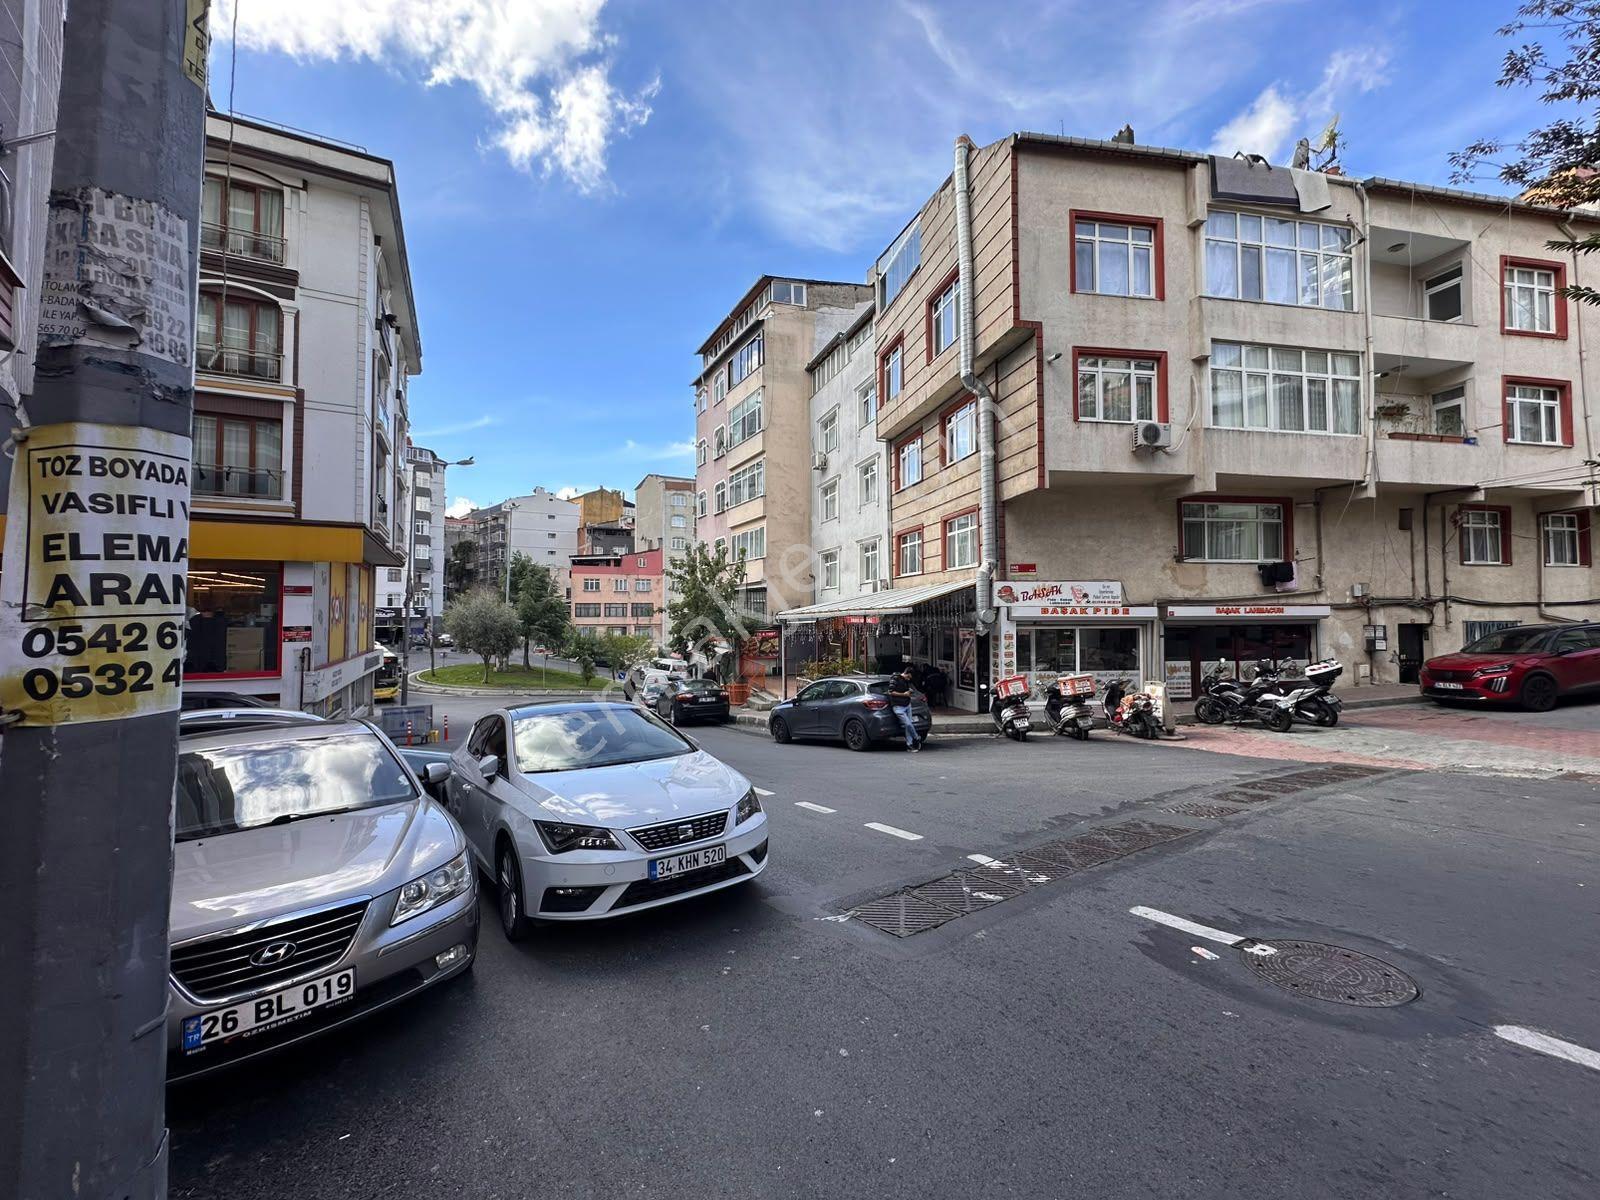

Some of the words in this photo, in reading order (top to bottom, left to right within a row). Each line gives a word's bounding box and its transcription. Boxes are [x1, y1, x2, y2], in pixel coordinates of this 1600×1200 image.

[58, 325, 70, 335] 70
[72, 326, 88, 337] 04
[37, 455, 82, 482] TOZ
[89, 457, 188, 487] BOYADA
[42, 492, 174, 519] VASIFLI
[43, 533, 188, 563] ELEMA
[21, 622, 148, 658] 0542
[22, 662, 154, 701] 0532
[657, 859, 673, 876] 34
[678, 853, 699, 871] KHN
[704, 847, 724, 864] 520
[201, 1009, 239, 1041] 26
[254, 995, 296, 1024] BL
[303, 973, 352, 1007] 019
[187, 1033, 200, 1043] TR
